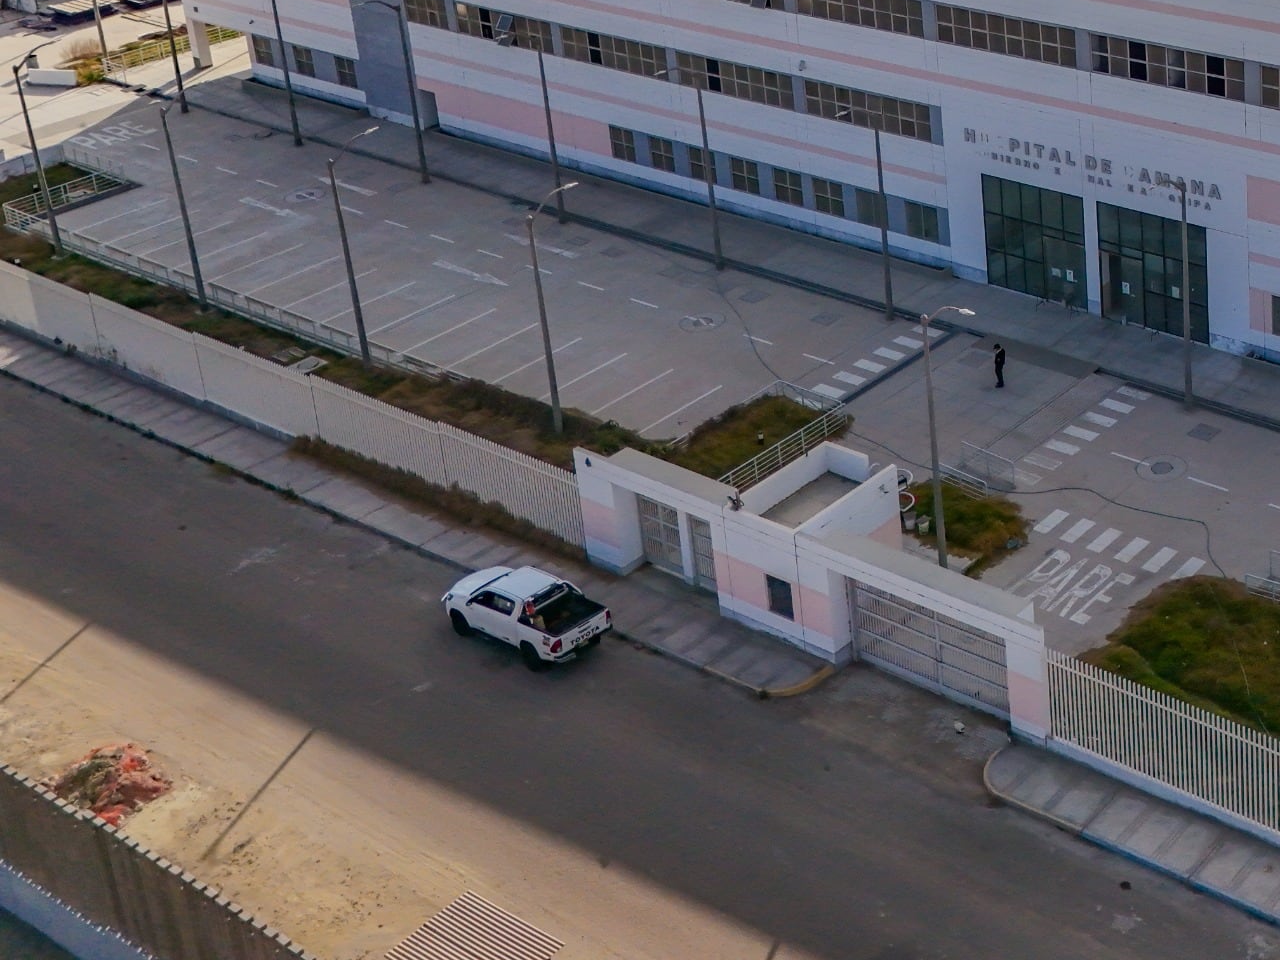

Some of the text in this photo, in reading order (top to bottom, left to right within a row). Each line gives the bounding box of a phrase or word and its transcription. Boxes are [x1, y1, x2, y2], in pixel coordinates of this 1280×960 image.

[69, 121, 158, 150] PARE
[963, 127, 1222, 200] HPITAL DE AMANA
[976, 150, 1040, 170] BIERNO
[1006, 549, 1135, 625] PARE
[570, 625, 600, 646] TOYOTA
